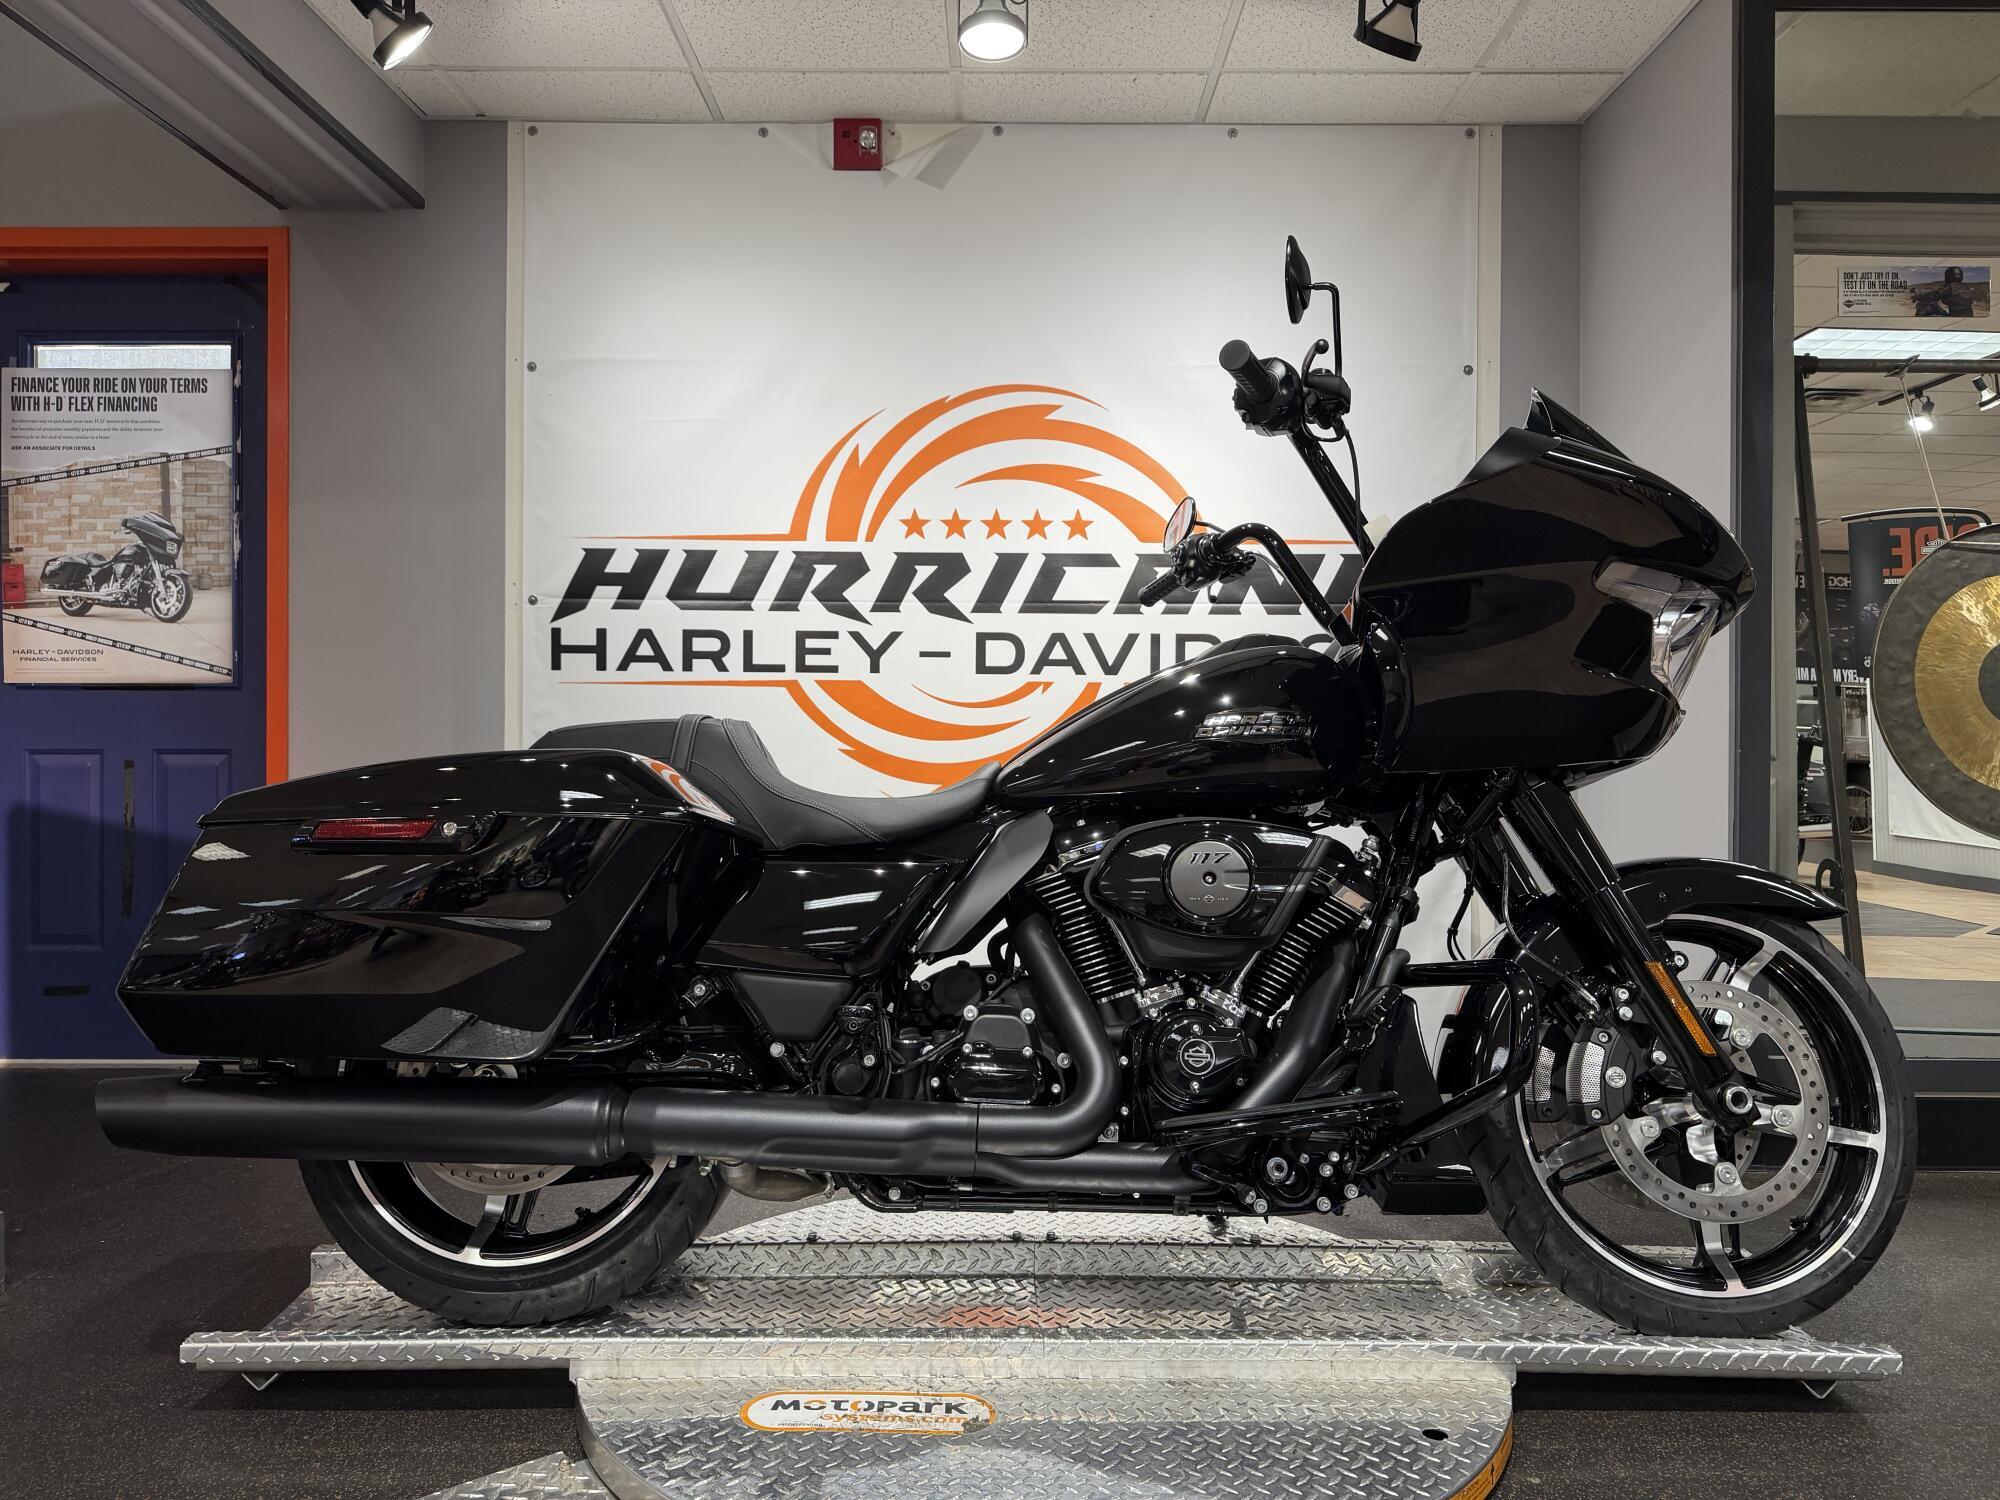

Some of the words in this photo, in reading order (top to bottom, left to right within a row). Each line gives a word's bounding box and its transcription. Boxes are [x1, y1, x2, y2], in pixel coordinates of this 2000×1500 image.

[1843, 271, 1858, 280] DON'T
[1860, 271, 1873, 280] JUST
[1874, 271, 1884, 280] TRY
[1884, 271, 1890, 280] IT
[1843, 280, 1858, 290] TEST
[1859, 280, 1866, 290] IT
[1867, 280, 1876, 290] ON
[1878, 280, 1889, 290] THE
[11, 376, 59, 393] FINANCE
[61, 377, 90, 393] YOUR
[93, 377, 118, 393] RIDE
[121, 377, 136, 393] ON
[139, 377, 168, 394] YOUR
[170, 377, 208, 394] TERMS
[11, 396, 40, 412] WITH
[68, 396, 94, 412] FLEX
[97, 396, 158, 412] FINANCING
[550, 547, 1365, 625] HURRICAN
[1189, 852, 1231, 865] 117
